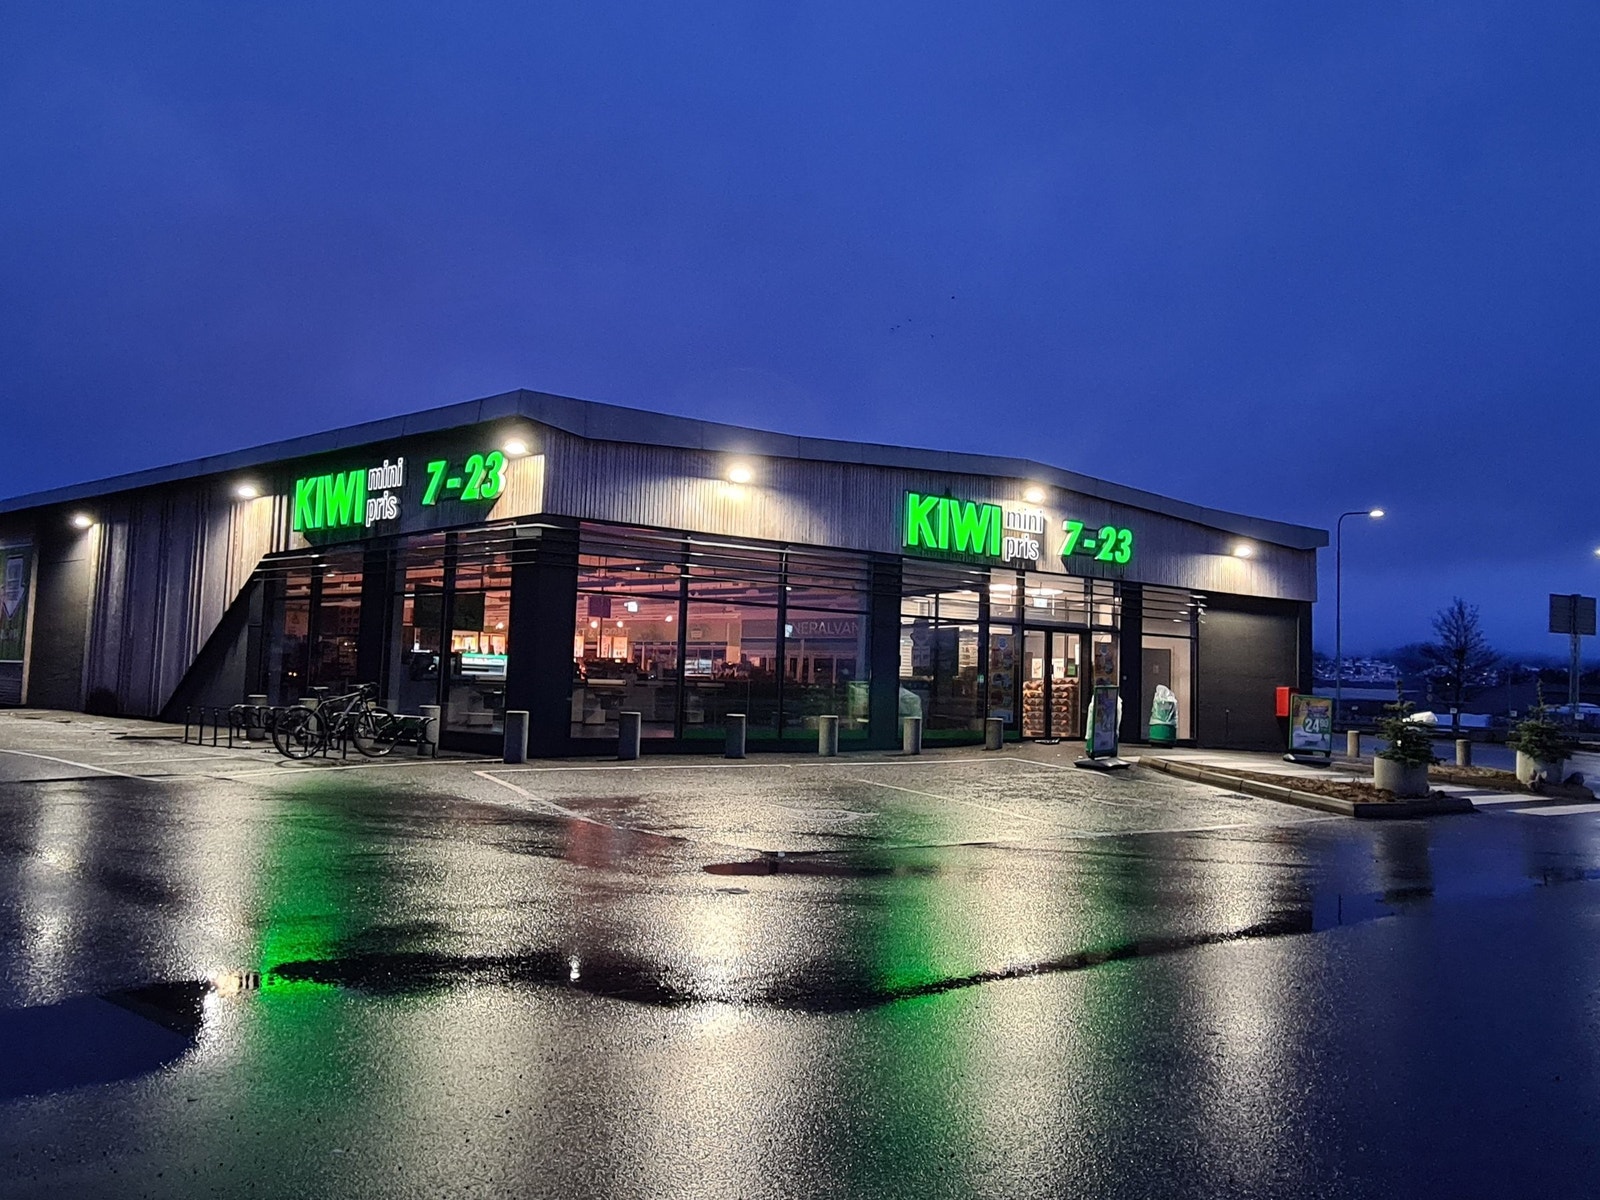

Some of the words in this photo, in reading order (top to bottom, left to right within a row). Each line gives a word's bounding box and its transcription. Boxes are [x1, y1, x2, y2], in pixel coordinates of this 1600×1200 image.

[368, 457, 404, 490] mini
[293, 468, 366, 531] KIWI
[365, 490, 397, 527] pris
[906, 493, 1002, 556] KIWI
[1005, 508, 1044, 534] mini
[1004, 533, 1040, 562] pris
